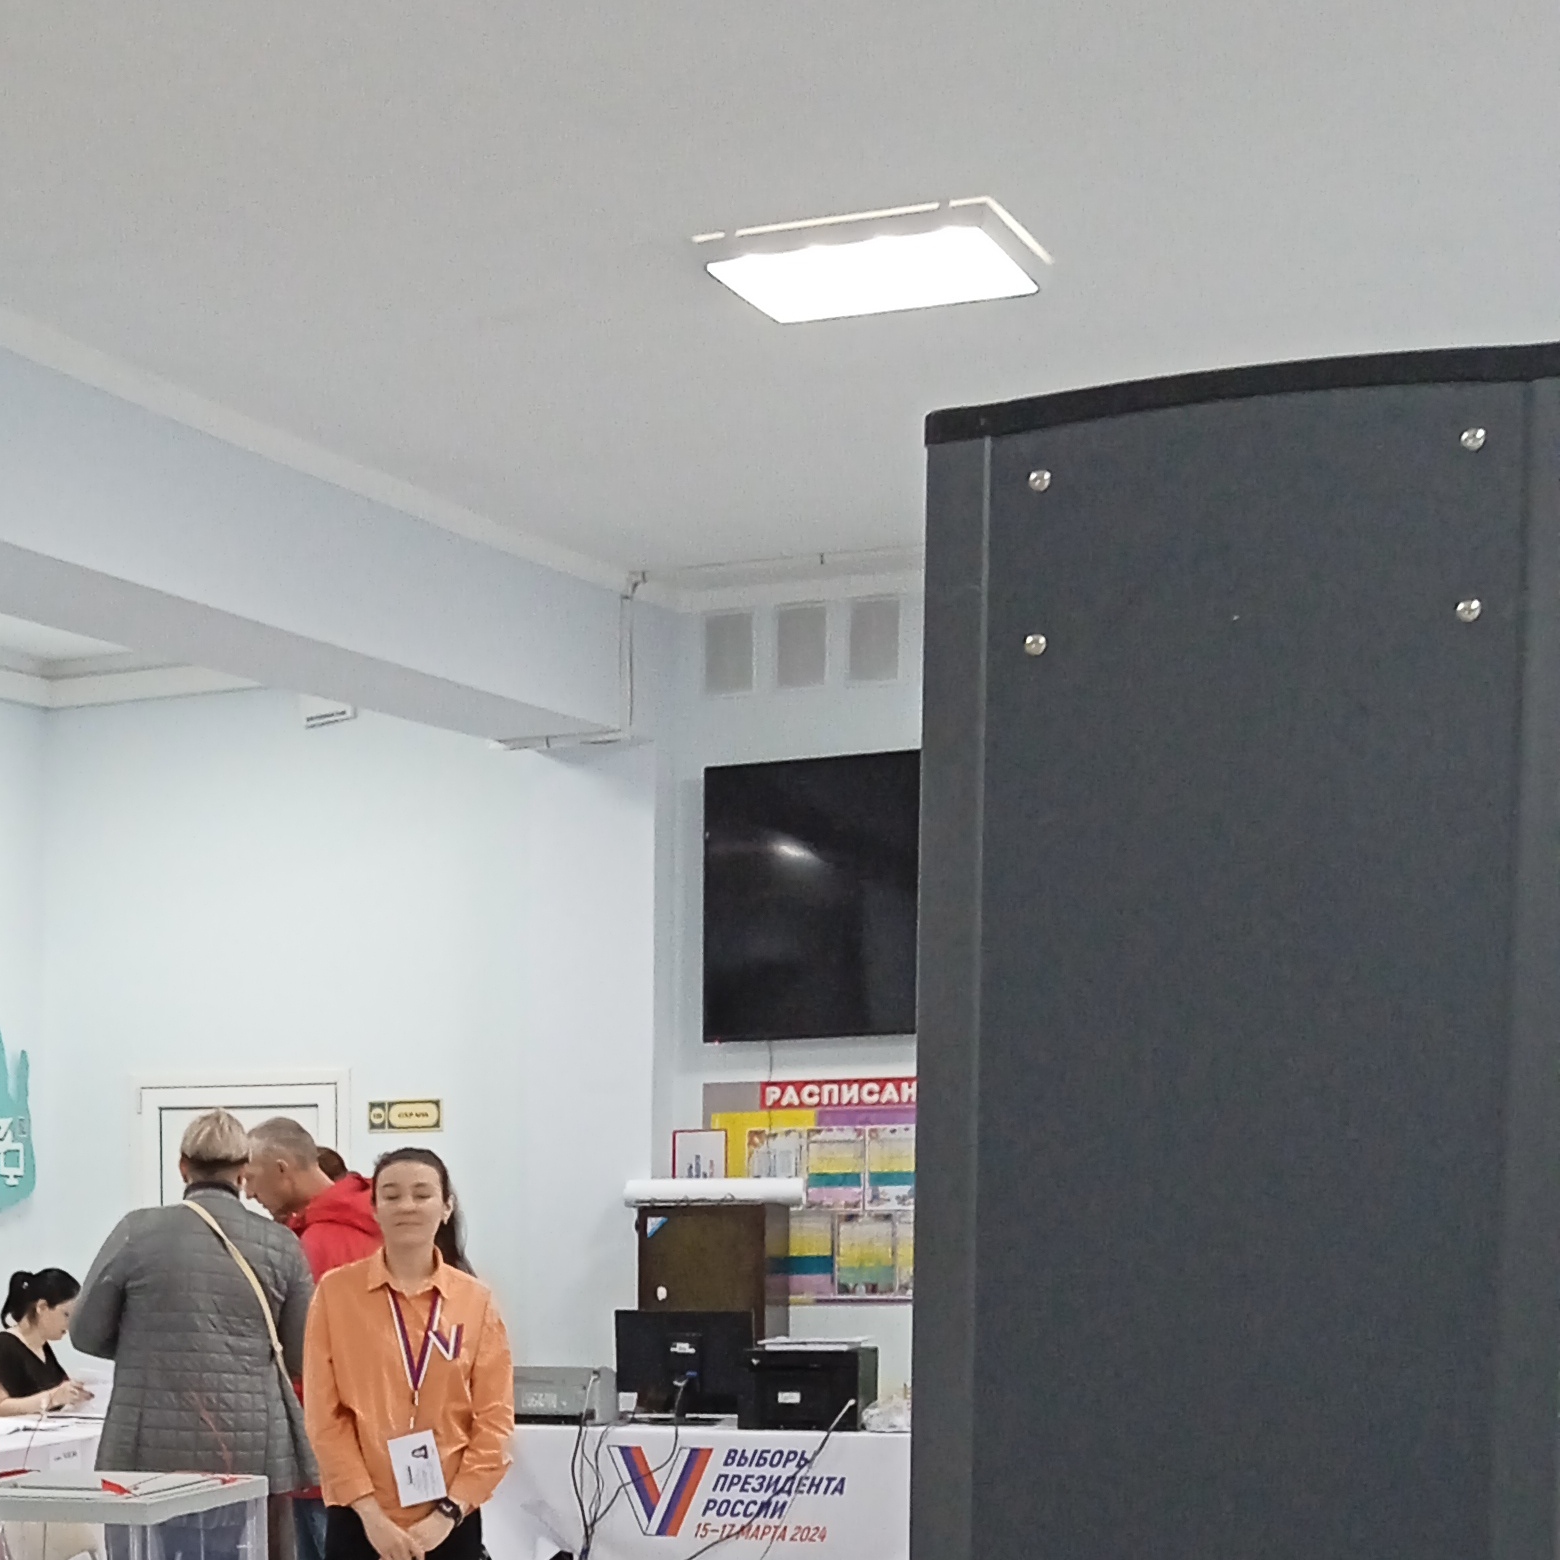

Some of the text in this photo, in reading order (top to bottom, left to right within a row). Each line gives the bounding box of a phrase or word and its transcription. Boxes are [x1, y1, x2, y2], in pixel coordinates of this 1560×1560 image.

[765, 1080, 917, 1107] РАСПИСАН
[712, 1473, 847, 1497] ПРЕЗИДЕНТА
[701, 1498, 789, 1519] РОССИИ
[736, 1524, 788, 1542] МАРТА
[789, 1525, 828, 1543] 2024
